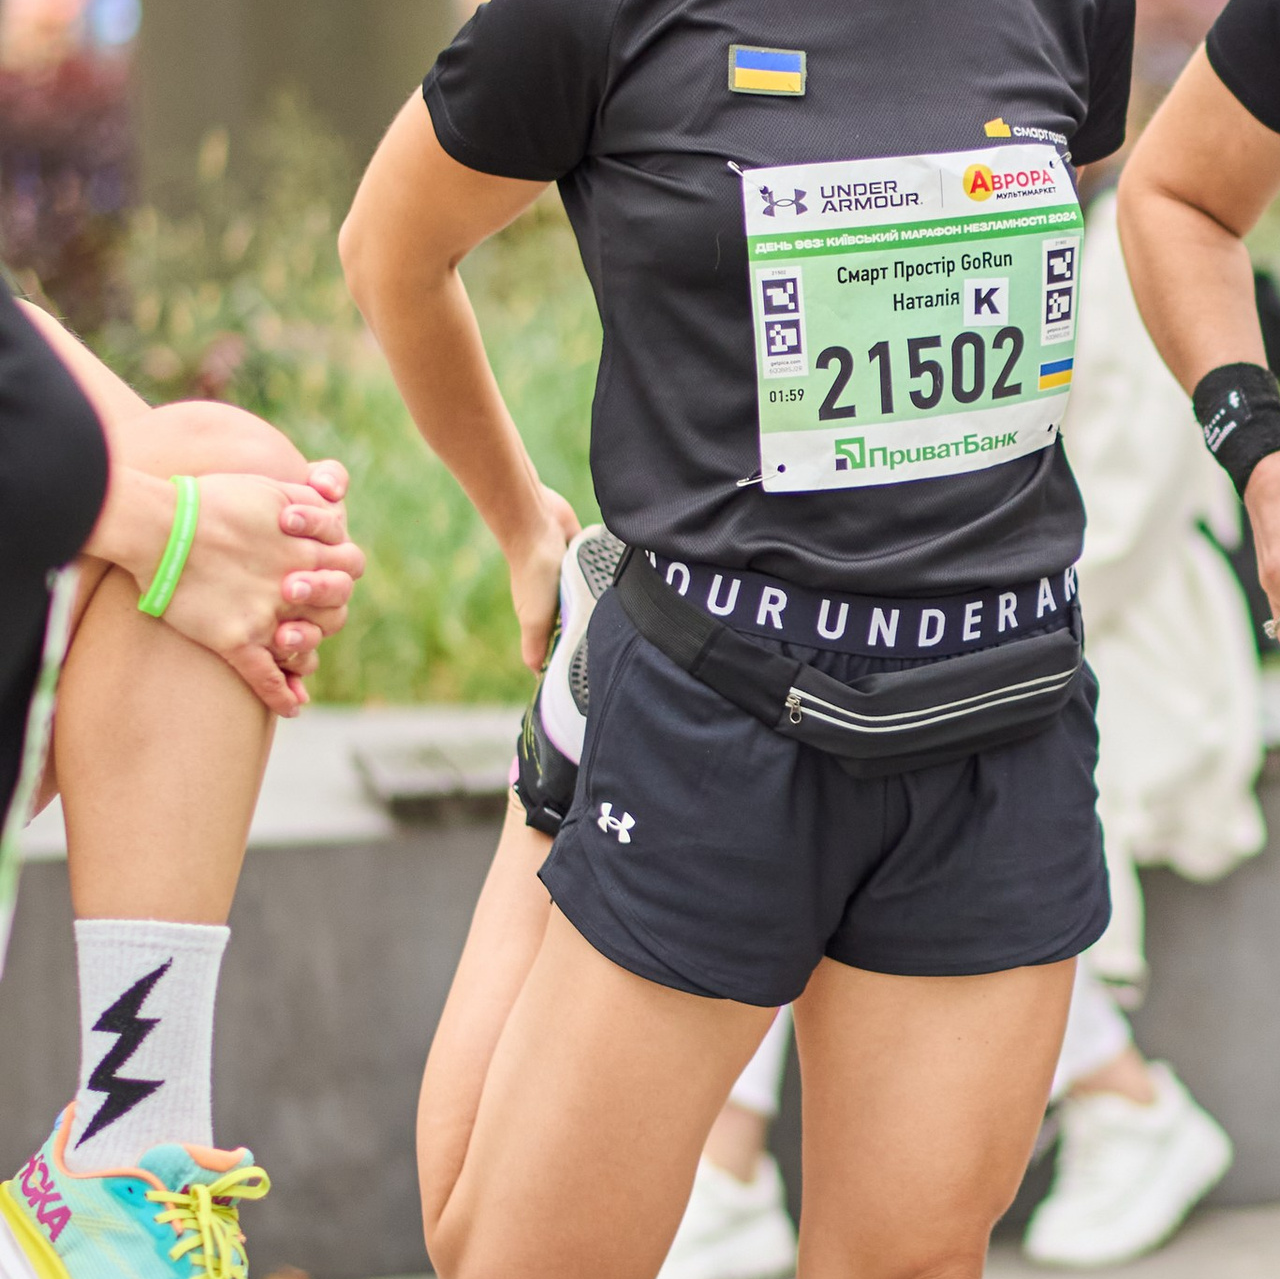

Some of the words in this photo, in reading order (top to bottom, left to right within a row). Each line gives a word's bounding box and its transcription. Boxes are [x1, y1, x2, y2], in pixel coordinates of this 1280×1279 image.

[1012, 126, 1049, 142] смарт
[820, 179, 898, 200] UNDER
[969, 168, 1055, 194] АВРОРА
[996, 186, 1057, 200] МУЛЬТИМАРКЕТ
[754, 241, 793, 255] ДЕНЬ
[826, 229, 899, 248] КИЇВСЬКИЙ
[900, 224, 962, 241] МАРАФОН
[963, 217, 1047, 235] НЕЗЛАМНОСТІ
[1049, 211, 1078, 224] 2024
[837, 265, 888, 285] Смарт
[894, 256, 956, 282] Простір
[961, 251, 1013, 271] GoRun
[892, 289, 960, 312] Наталія
[814, 326, 1025, 421] 21502
[769, 388, 805, 403] 01:59
[869, 430, 1019, 470] ПриватБанк
[817, 591, 1019, 648] UNDER
